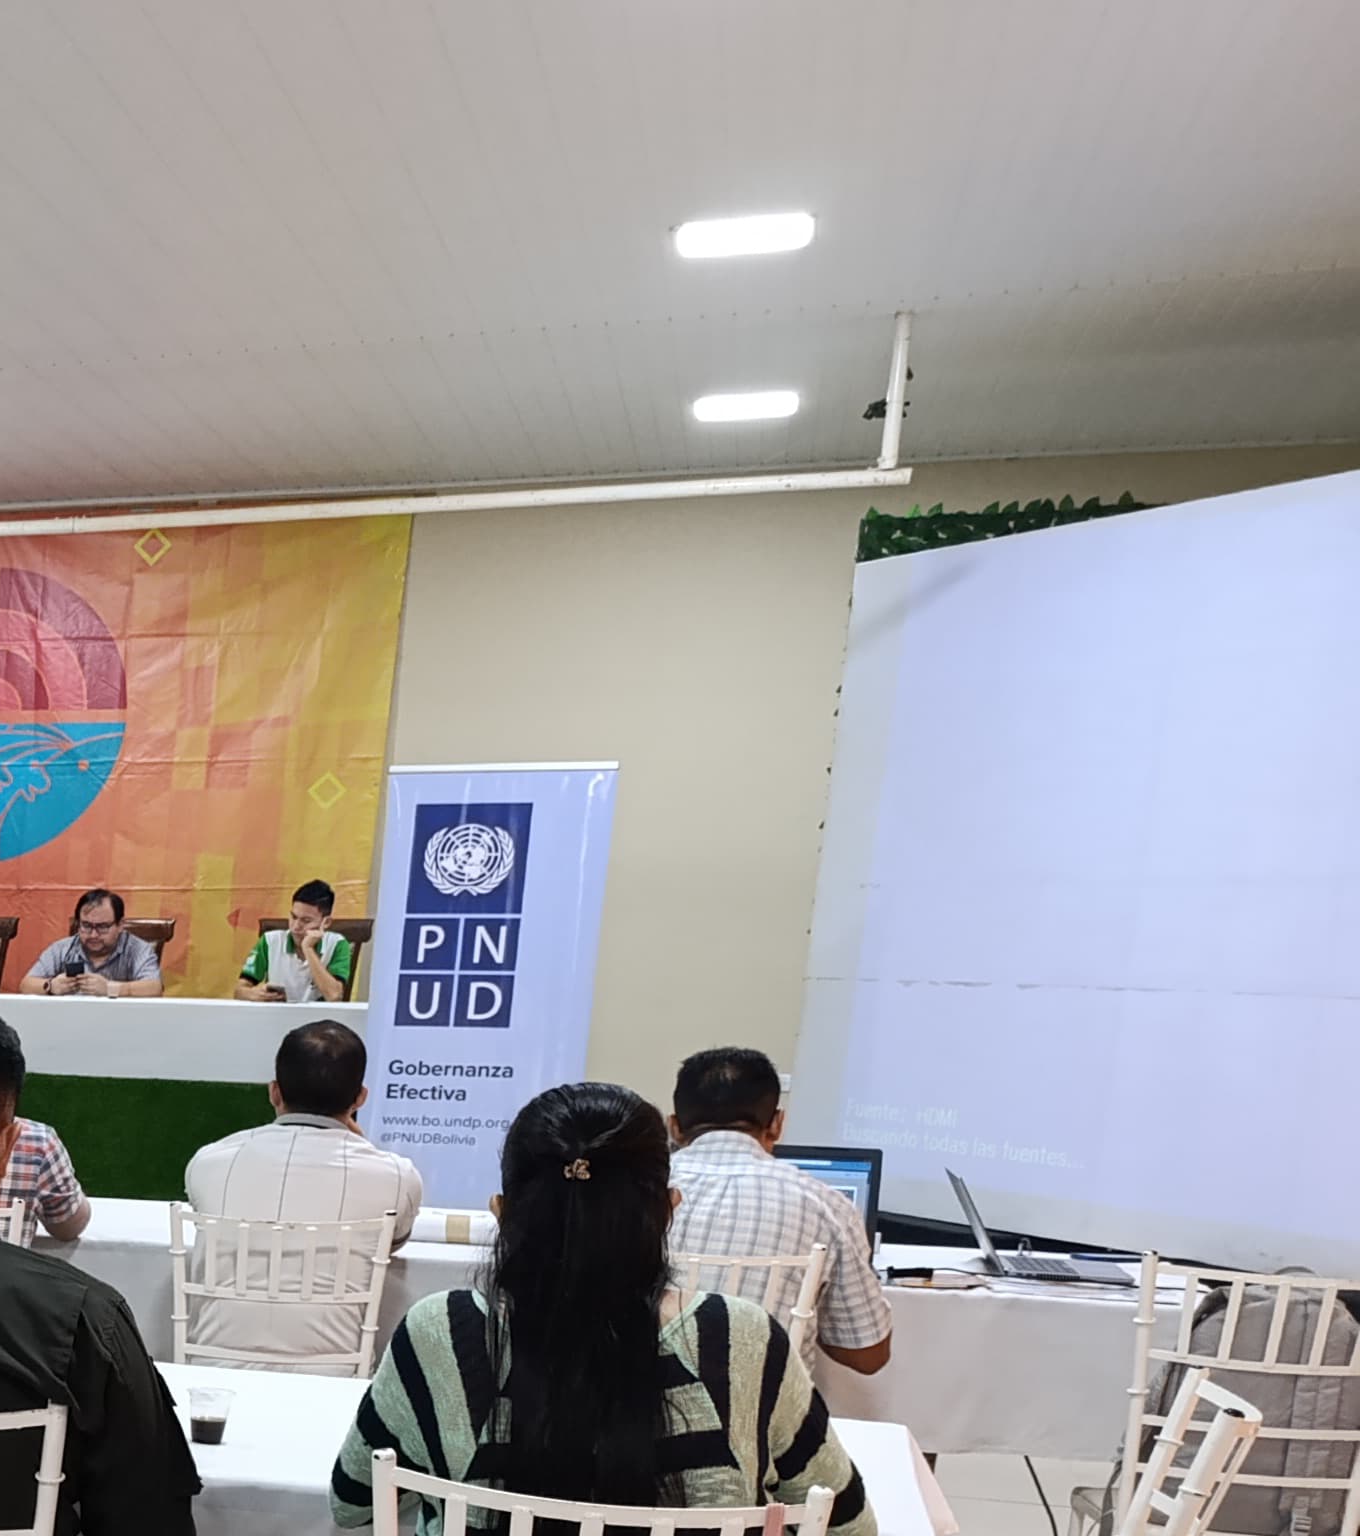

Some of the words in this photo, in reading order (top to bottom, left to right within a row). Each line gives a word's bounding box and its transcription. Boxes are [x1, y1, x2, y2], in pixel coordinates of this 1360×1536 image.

[388, 1059, 514, 1078] Gobernanza
[385, 1083, 467, 1101] Efectiva
[380, 1132, 476, 1146] @PNUDBolivia
[924, 1132, 969, 1154] todas
[972, 1139, 995, 1158] las
